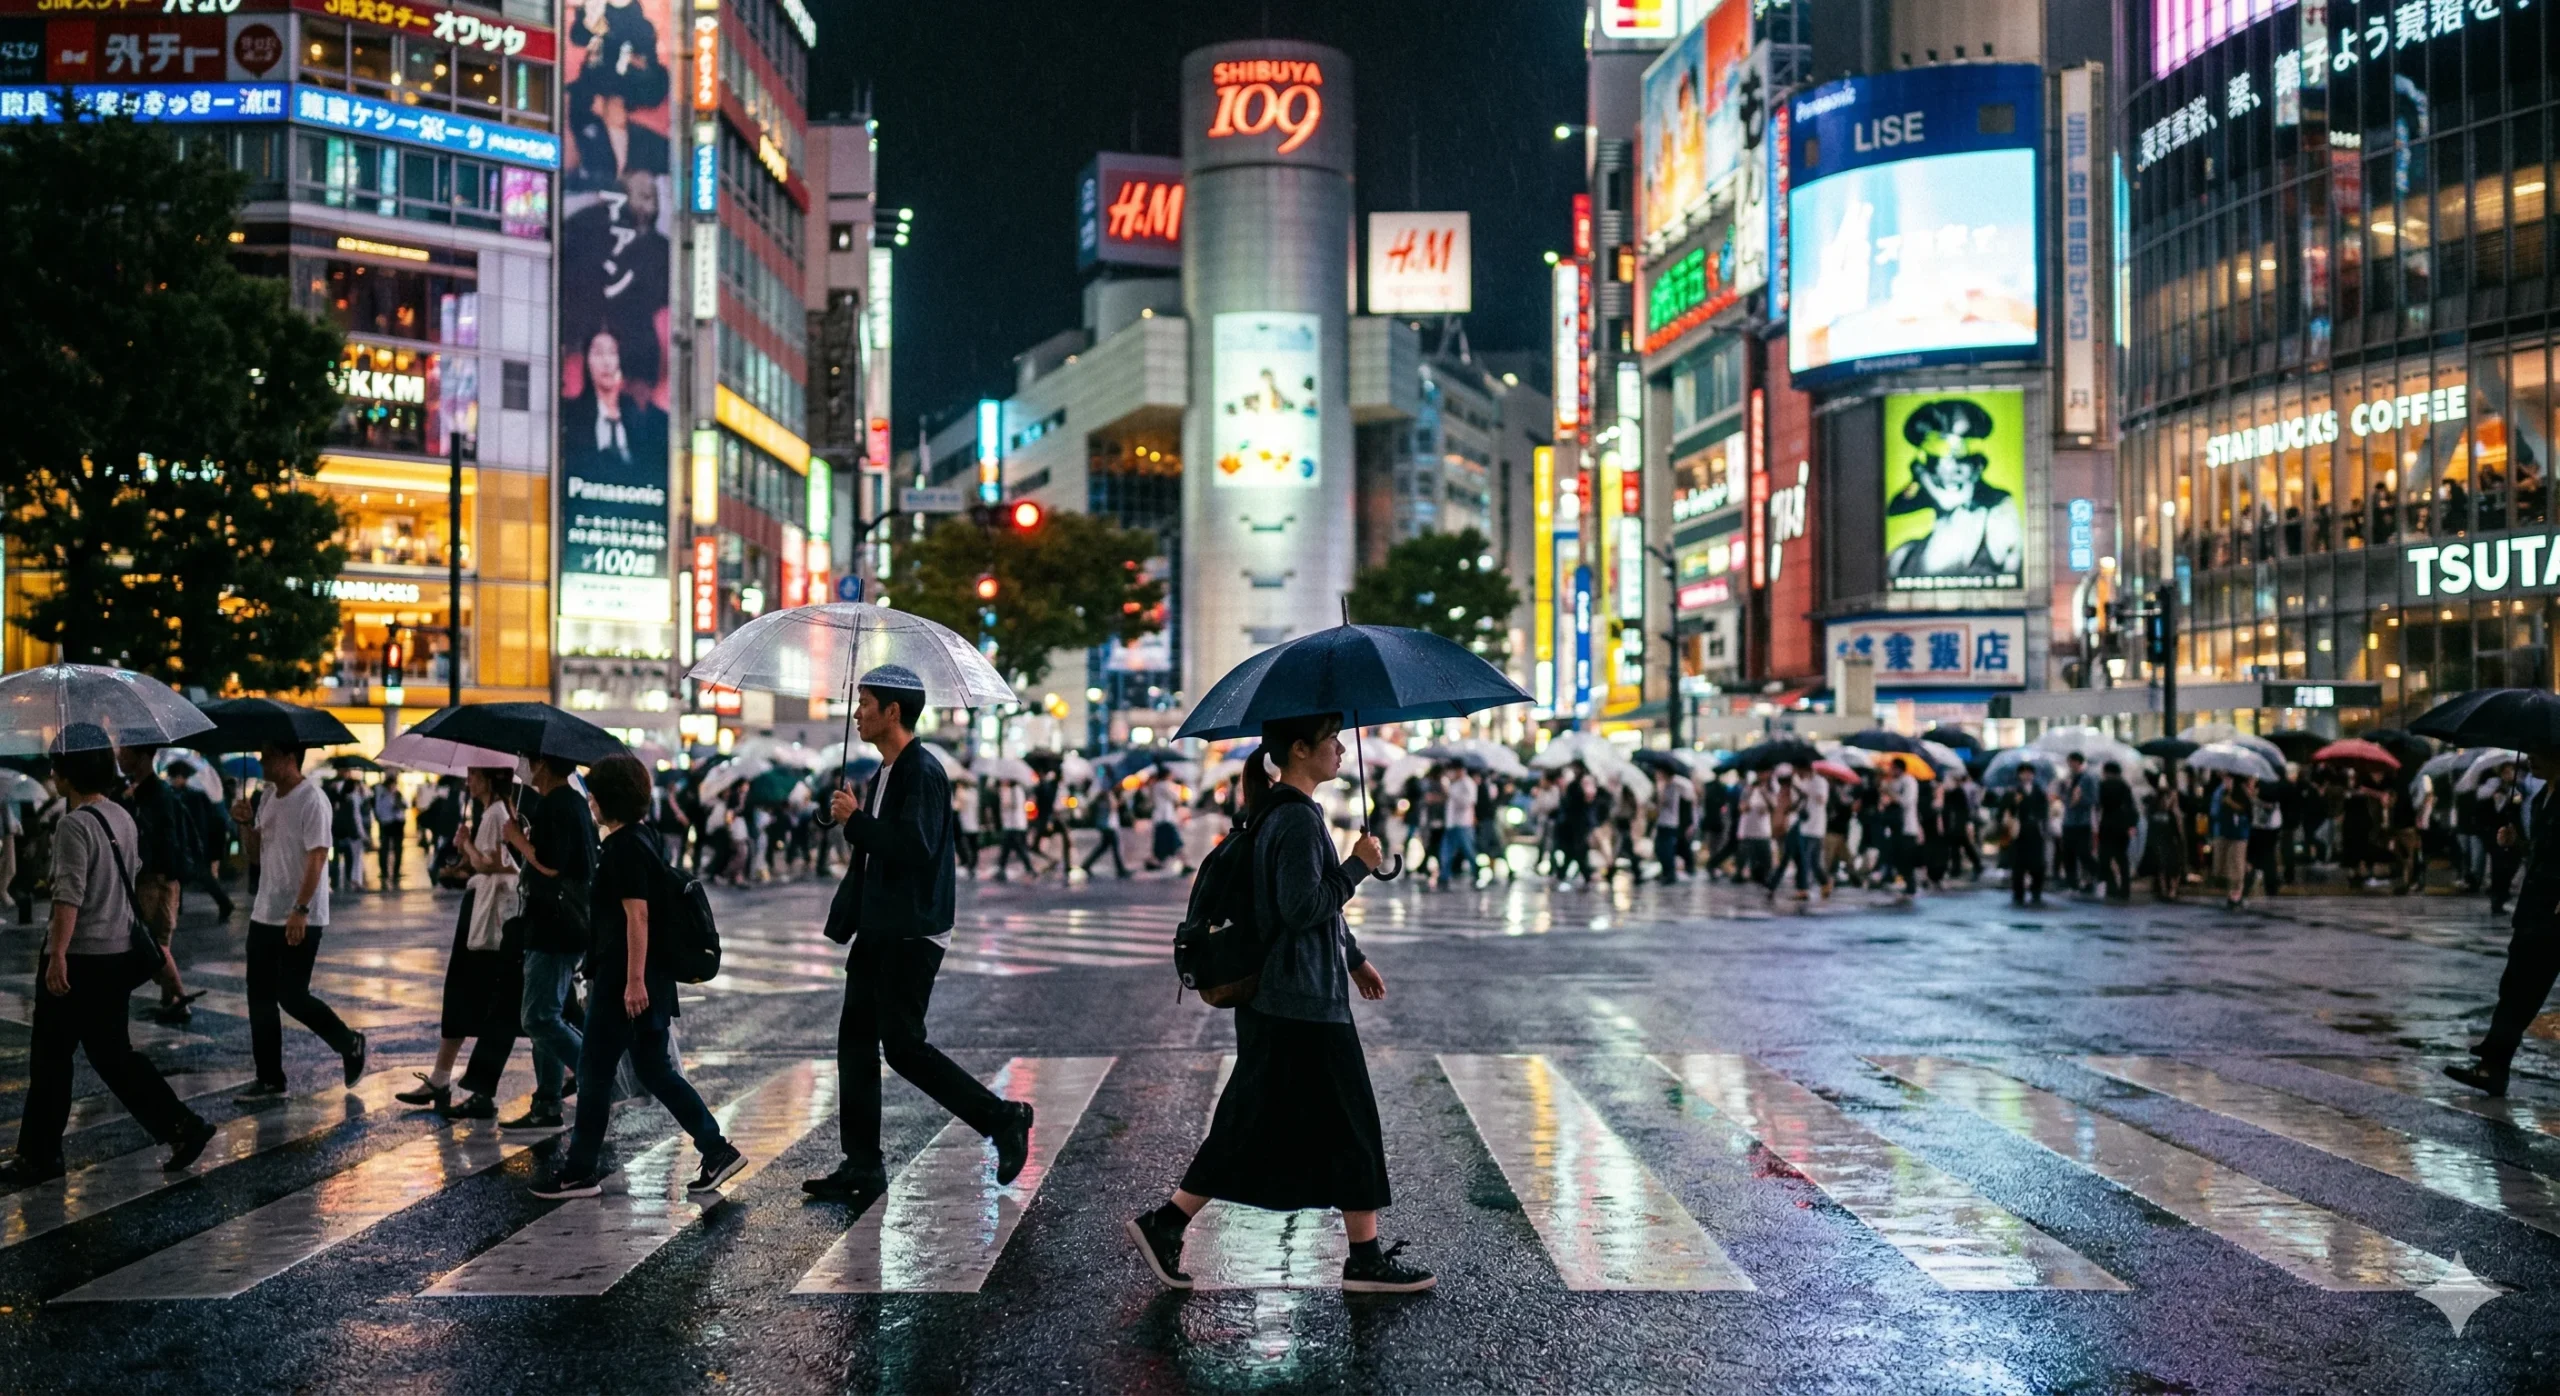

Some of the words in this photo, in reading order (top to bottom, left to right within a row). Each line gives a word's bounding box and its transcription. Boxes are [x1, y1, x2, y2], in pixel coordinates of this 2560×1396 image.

[1213, 60, 1323, 86] SHIBUYA
[1208, 83, 1322, 154] 109
[1854, 110, 1925, 152] LISE
[1385, 228, 1456, 274] HM
[2206, 410, 2339, 469] STARBUCKS
[2351, 384, 2468, 437] COFFEE
[568, 476, 665, 506] Panasonic
